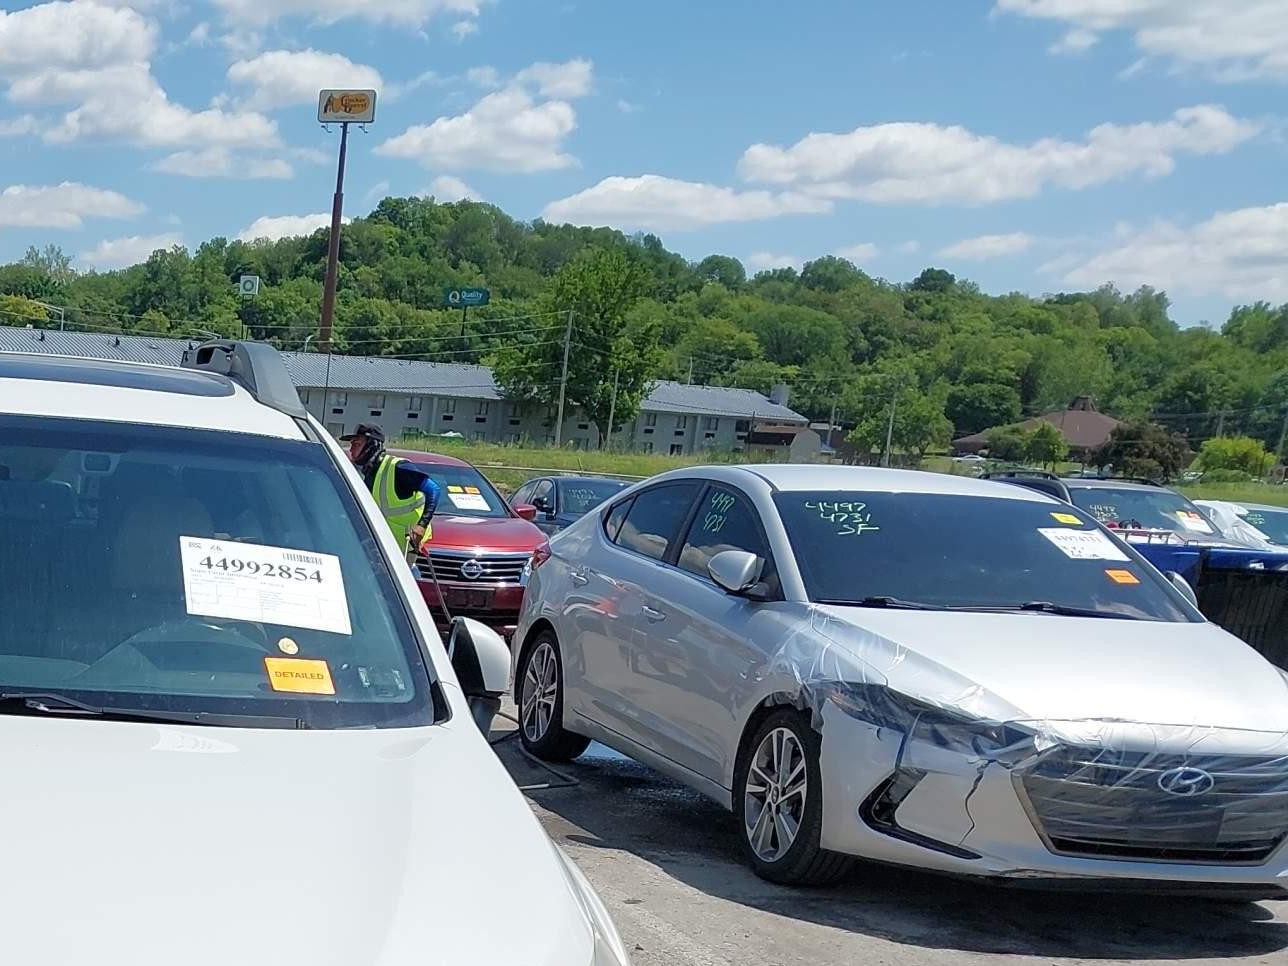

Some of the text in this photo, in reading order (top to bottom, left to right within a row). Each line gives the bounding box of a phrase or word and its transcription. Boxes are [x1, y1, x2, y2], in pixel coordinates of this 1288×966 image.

[461, 290, 483, 300] Quality
[805, 501, 867, 513] 4497
[703, 511, 728, 534] 4731
[820, 512, 872, 523] 4731
[837, 523, 881, 536] SF
[199, 556, 325, 584] 44992854
[274, 671, 325, 680] DETAILED
